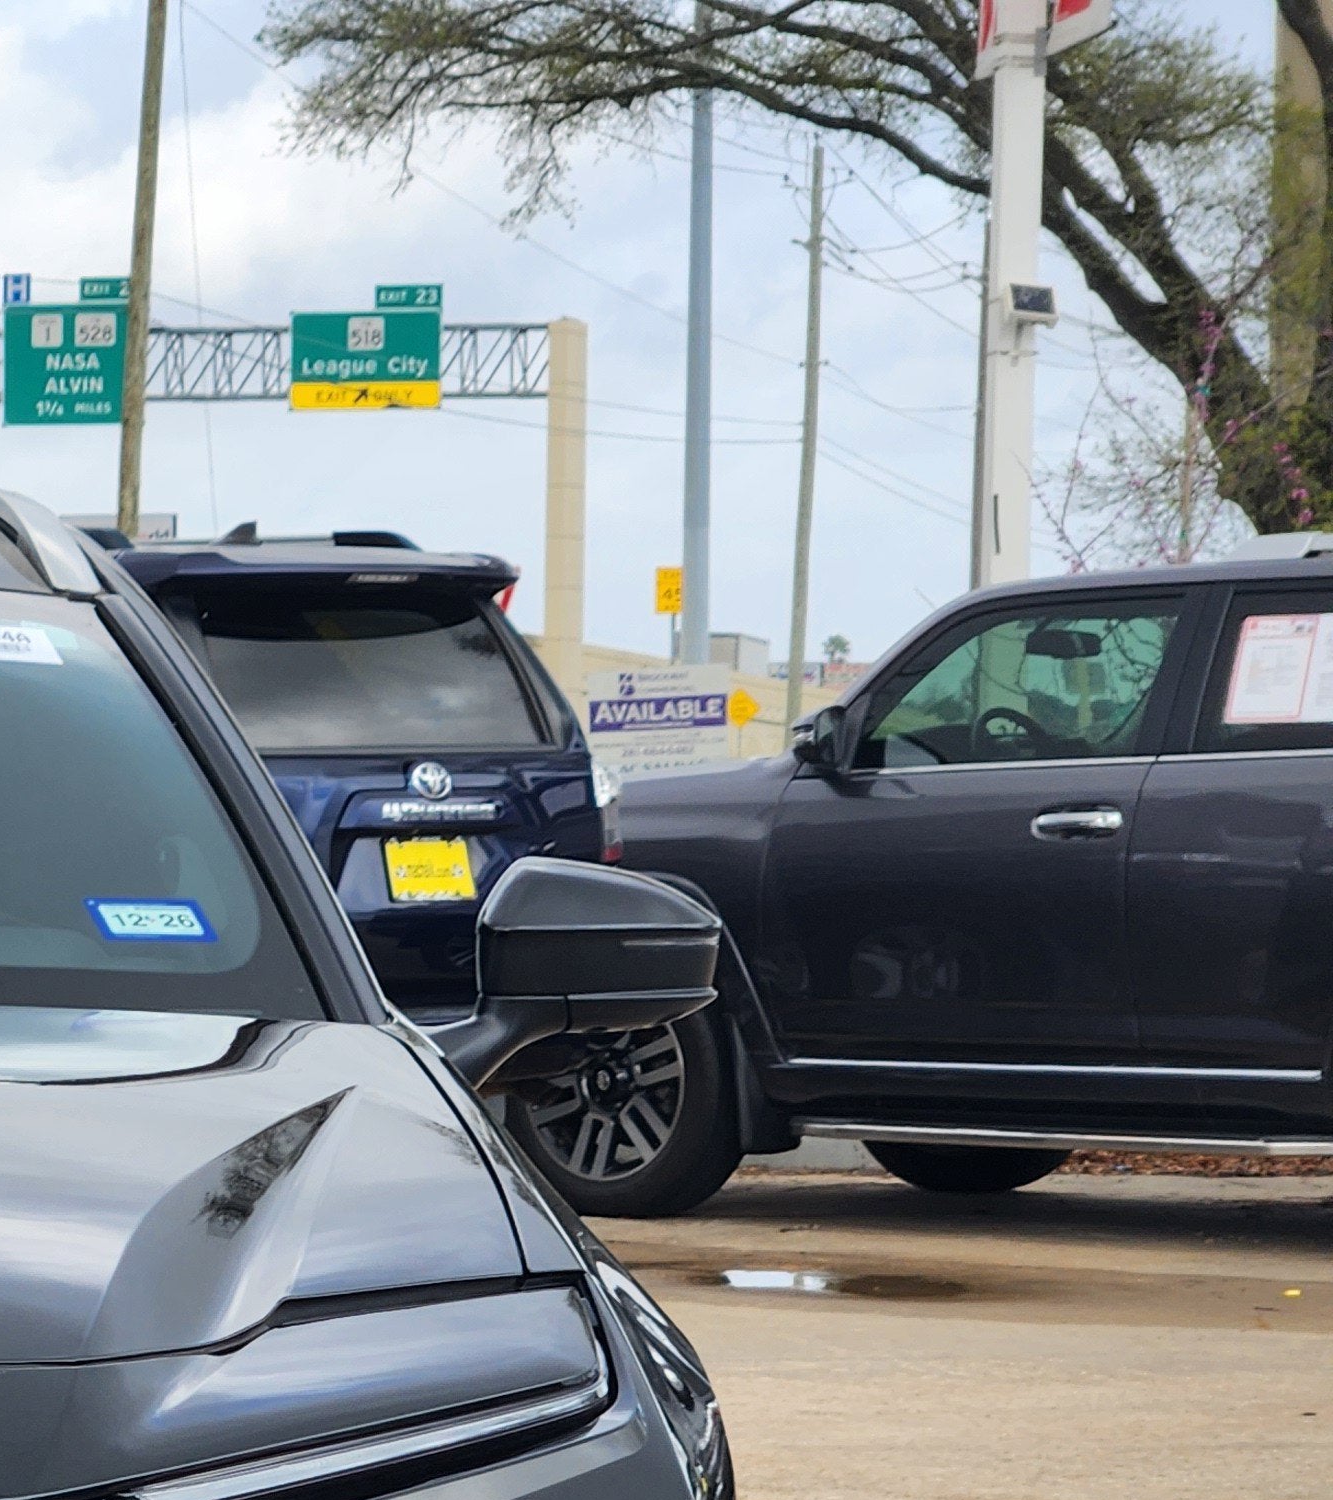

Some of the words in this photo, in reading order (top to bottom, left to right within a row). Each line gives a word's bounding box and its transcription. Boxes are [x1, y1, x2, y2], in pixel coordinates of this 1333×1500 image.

[82, 282, 110, 296] EXIT
[379, 290, 407, 303] EXIT
[415, 287, 439, 304] 23
[79, 325, 112, 343] 528
[351, 328, 382, 348] 518
[45, 352, 101, 371] NASA
[301, 356, 378, 379] League
[387, 353, 429, 378] City
[44, 375, 104, 395] ALVIN
[315, 390, 347, 403] EXIT
[74, 400, 112, 414] MILES
[594, 697, 723, 724] AVAILABLE
